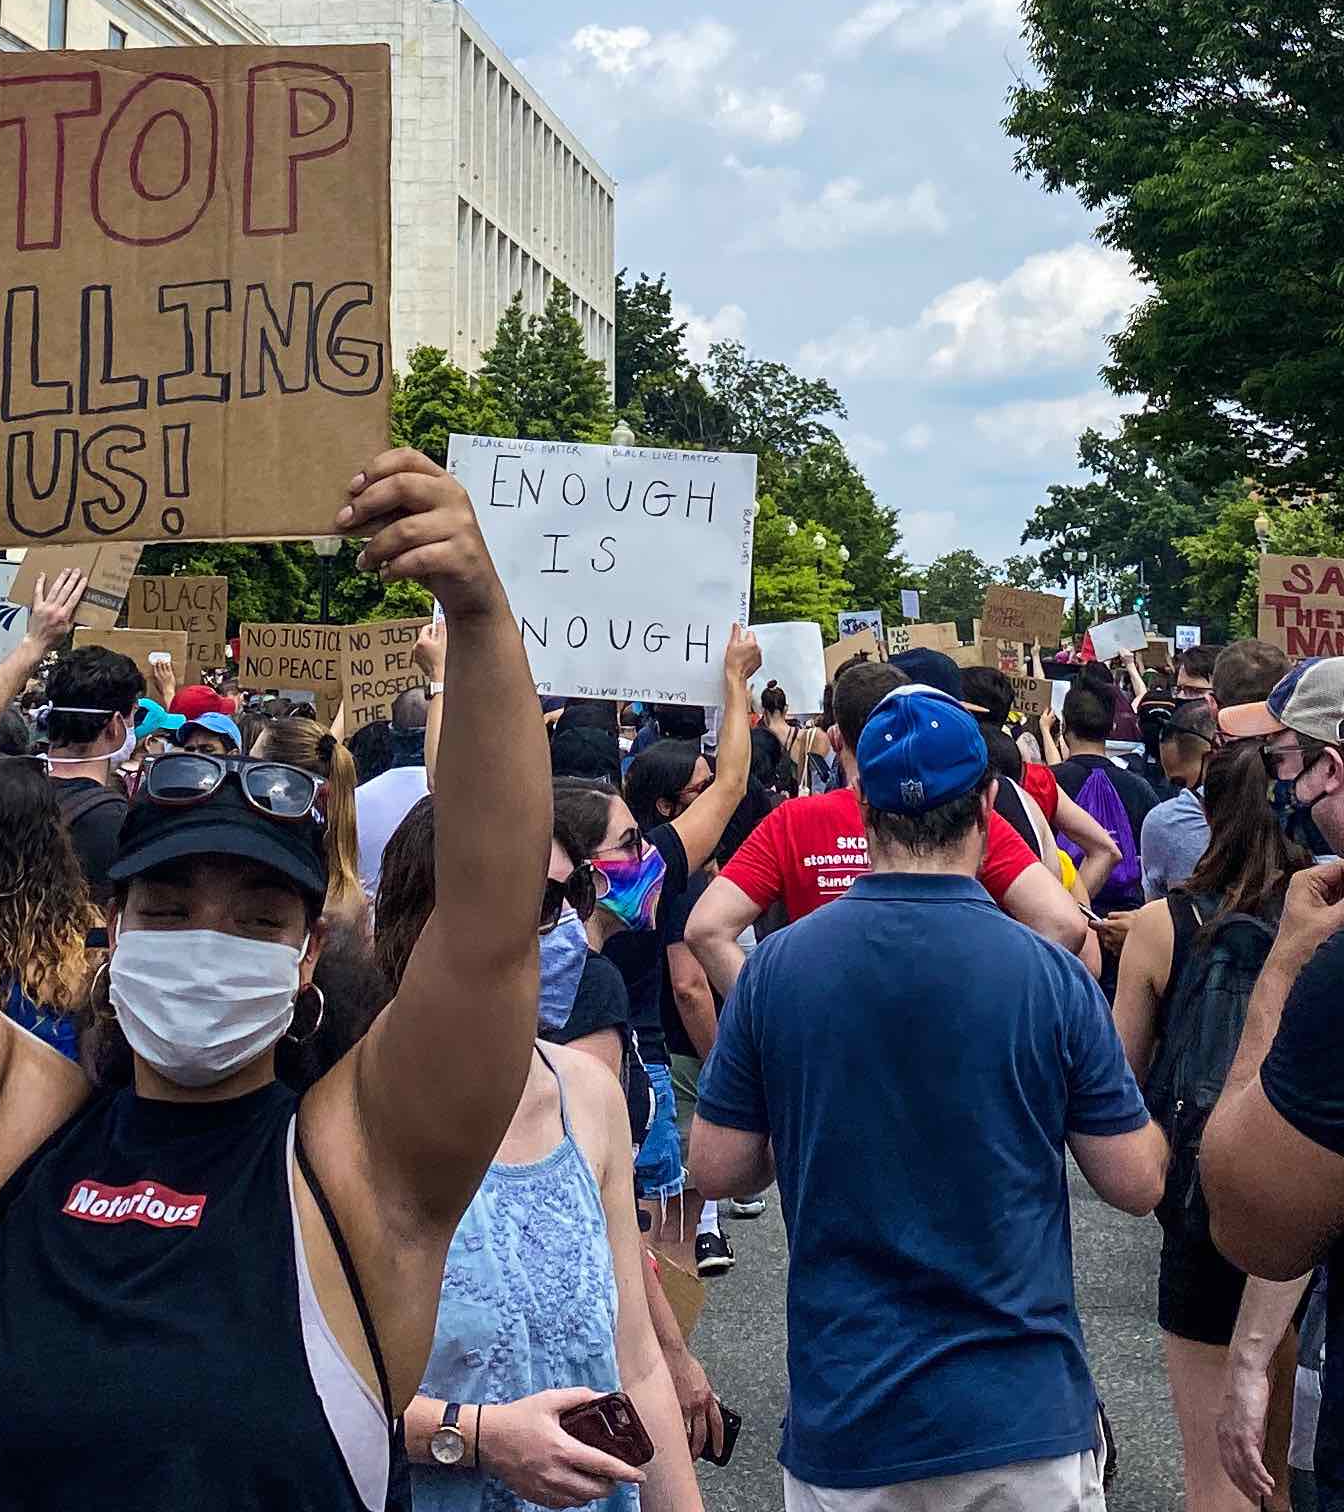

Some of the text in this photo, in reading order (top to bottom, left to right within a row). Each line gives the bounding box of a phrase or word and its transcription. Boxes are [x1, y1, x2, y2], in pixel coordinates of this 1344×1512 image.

[471, 439, 583, 457] BLACK LIVES MATTER
[612, 448, 721, 465] BLACK LIVES MATTER
[6, 423, 191, 538] US!
[489, 454, 716, 524] ENOUGH
[743, 508, 753, 536] BLACK
[540, 534, 617, 574] IS
[143, 579, 224, 614] BLACK
[155, 613, 218, 634] LIVES
[247, 628, 276, 649] NO
[348, 626, 422, 652] NO JUST
[520, 616, 711, 665] NOUGH
[187, 642, 225, 662] TER
[245, 656, 337, 681] NO PEACE
[350, 659, 374, 676] NO
[350, 675, 425, 701] PROSECU
[576, 684, 618, 696] MATTER
[622, 687, 651, 697] LIVES
[658, 689, 687, 702] BLACK
[352, 703, 387, 724] THE
[1013, 701, 1038, 713] LICE
[817, 874, 856, 888] Sund
[68, 1187, 200, 1224] Notorious
